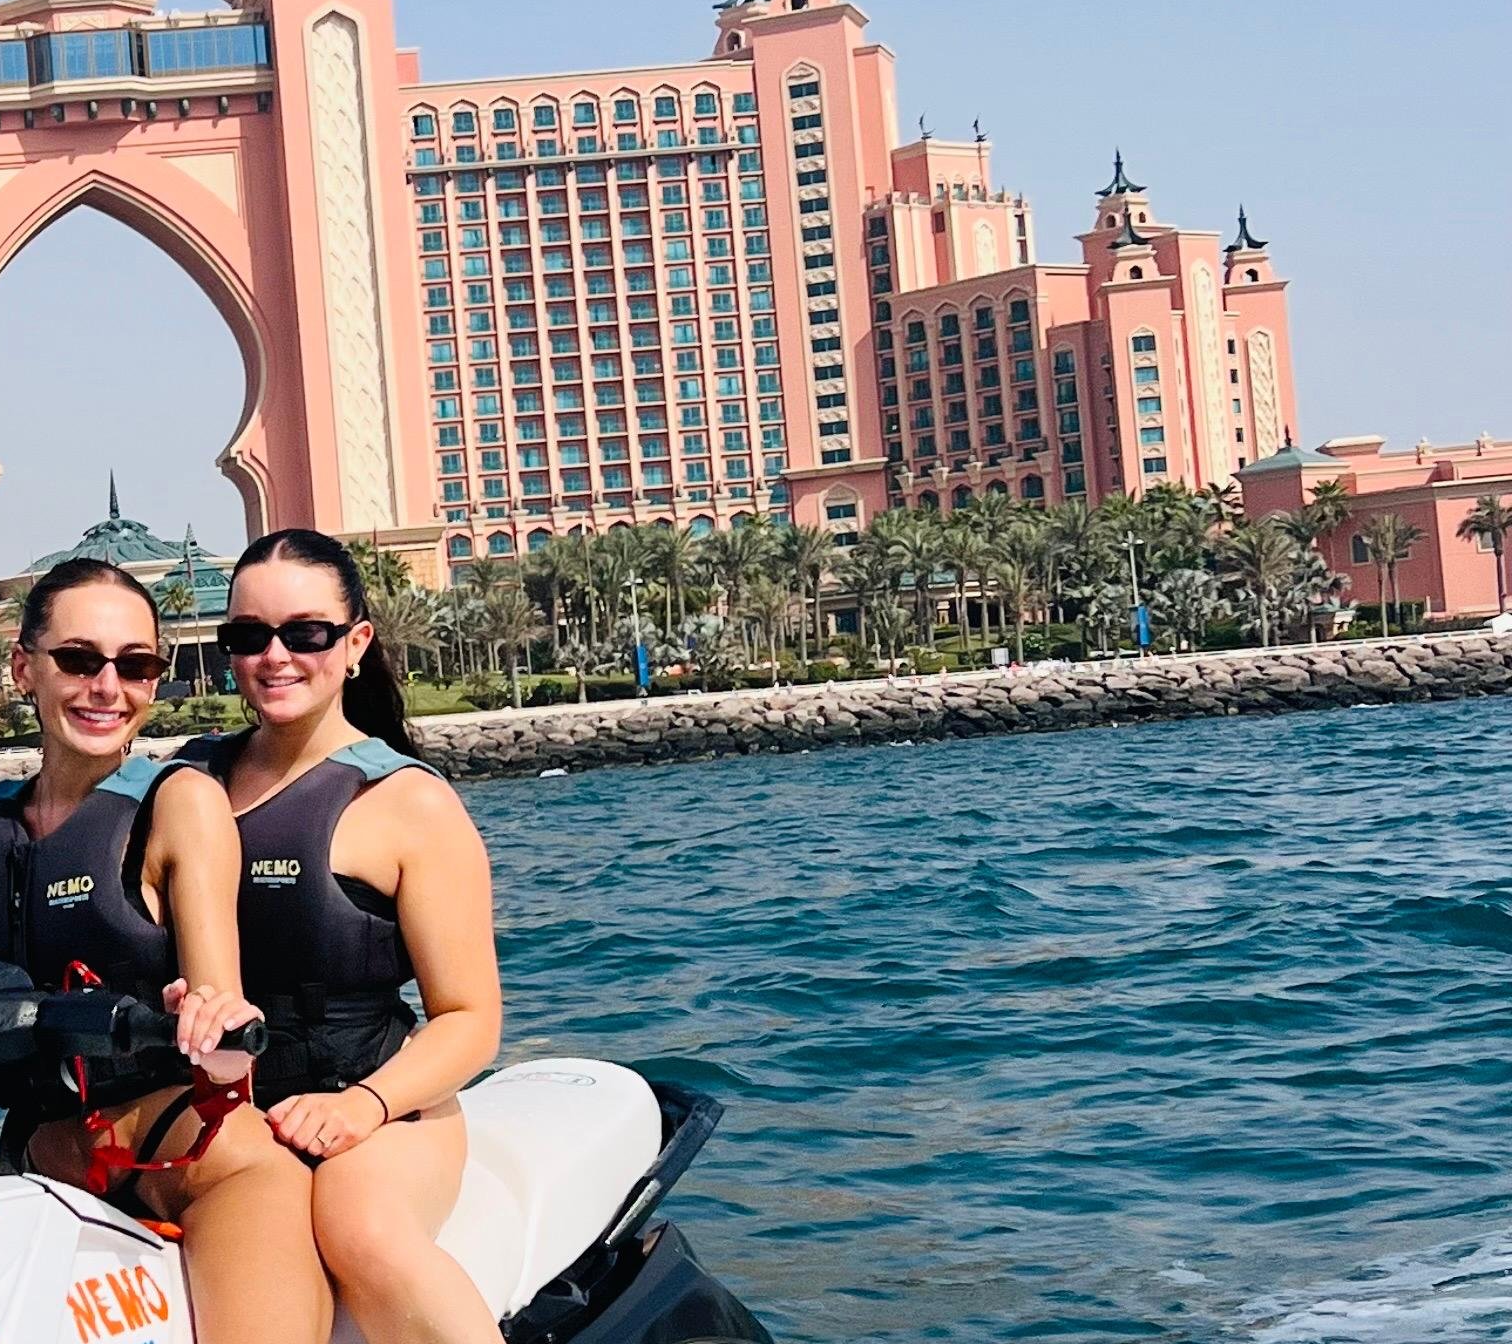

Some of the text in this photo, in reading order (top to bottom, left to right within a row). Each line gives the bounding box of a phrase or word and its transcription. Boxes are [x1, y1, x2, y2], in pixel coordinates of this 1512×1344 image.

[250, 859, 301, 876] NEMO
[46, 875, 95, 899] NEMO
[67, 1265, 170, 1344] NEMO
